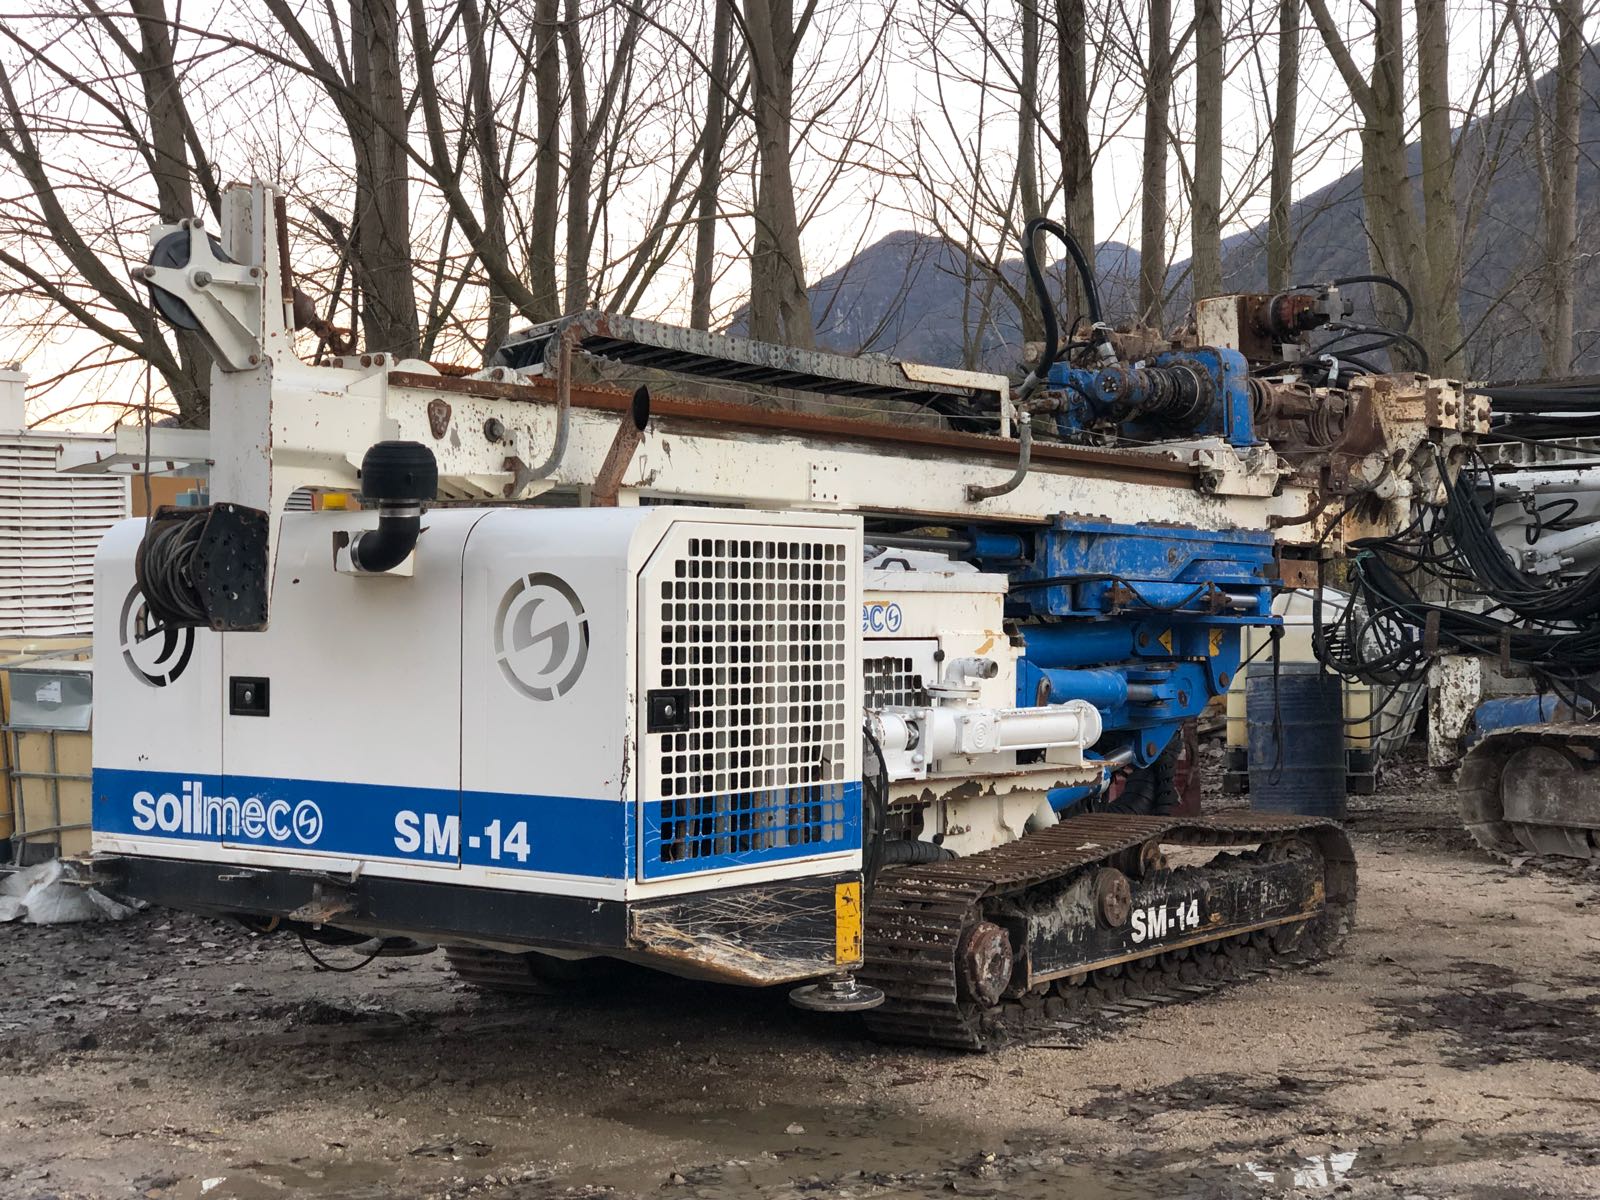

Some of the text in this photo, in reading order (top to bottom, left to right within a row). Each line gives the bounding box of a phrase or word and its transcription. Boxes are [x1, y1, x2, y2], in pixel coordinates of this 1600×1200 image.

[132, 781, 292, 841] soilmec
[393, 810, 531, 862] SM-14
[1130, 899, 1200, 944] SM-14
